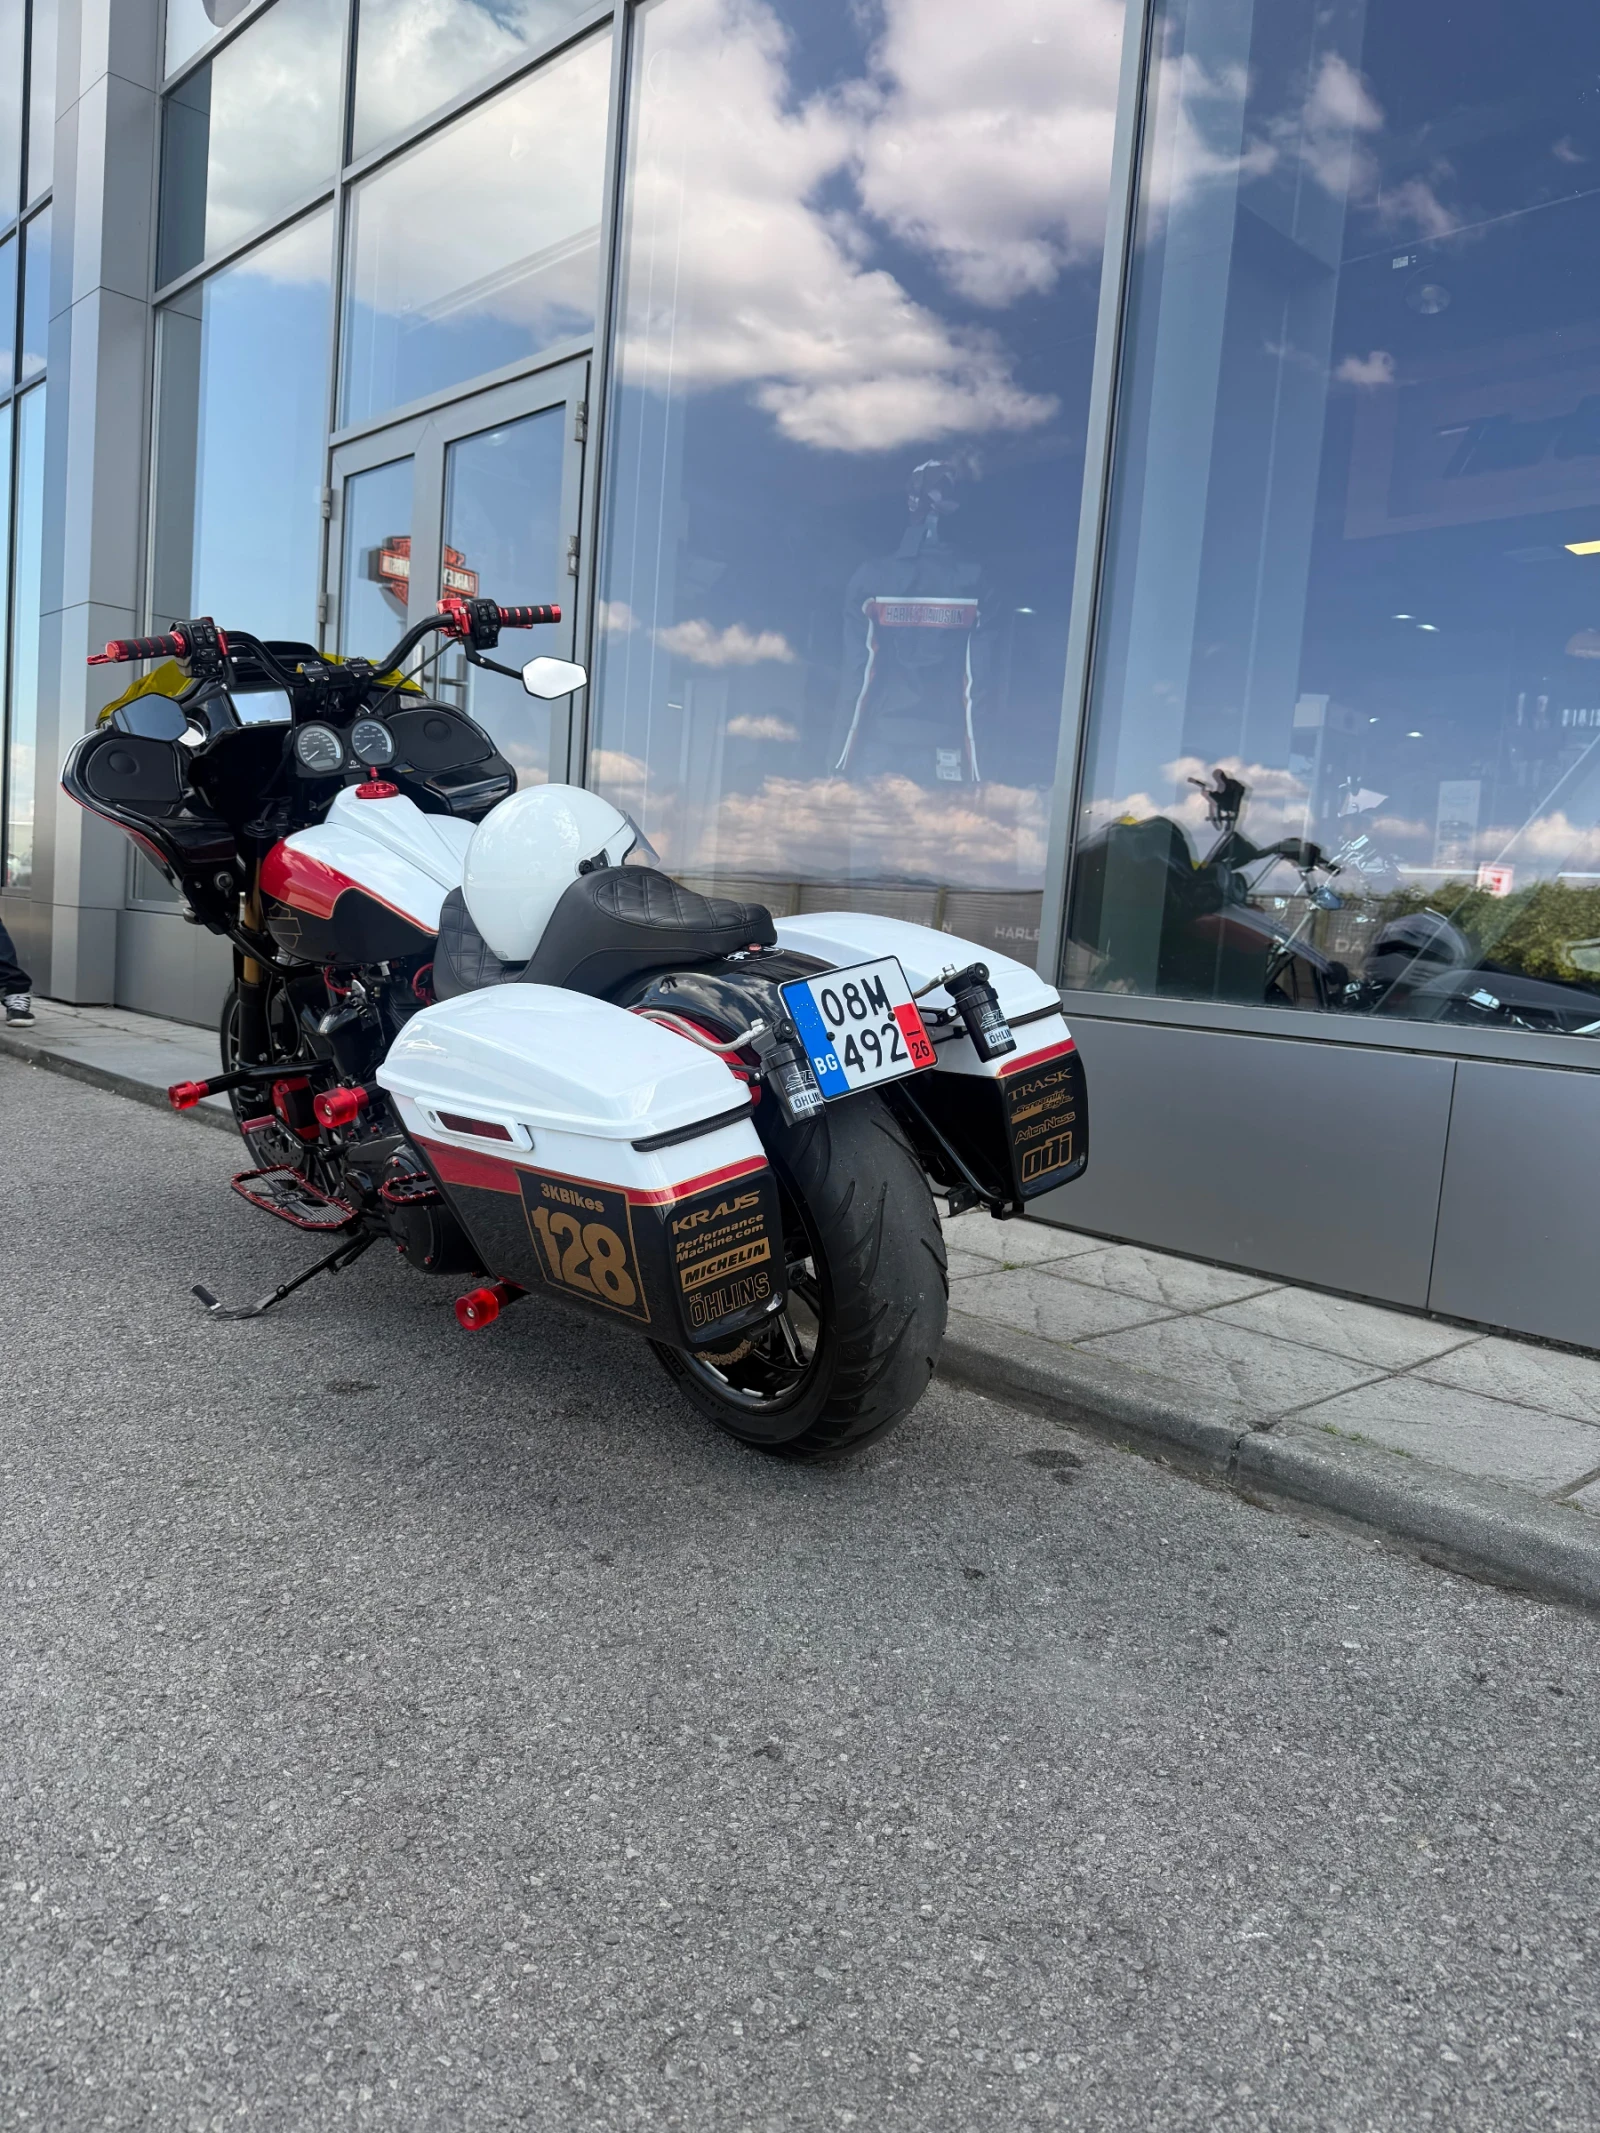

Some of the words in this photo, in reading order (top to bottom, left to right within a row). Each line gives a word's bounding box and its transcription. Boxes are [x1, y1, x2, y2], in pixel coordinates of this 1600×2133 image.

[821, 975, 892, 1026] 08M
[813, 1053, 838, 1075] BG
[844, 1023, 909, 1073] 492
[911, 1040, 930, 1060] 26
[1008, 1067, 1073, 1101] TRASK
[1041, 1095, 1074, 1111] Eagle
[672, 1190, 761, 1235] KRAUS
[676, 1214, 764, 1253] Performance
[531, 1206, 637, 1306] 128
[676, 1223, 764, 1264] Machine.com
[685, 1242, 766, 1285] MICHELIN
[689, 1272, 771, 1328] ÖHLINS
